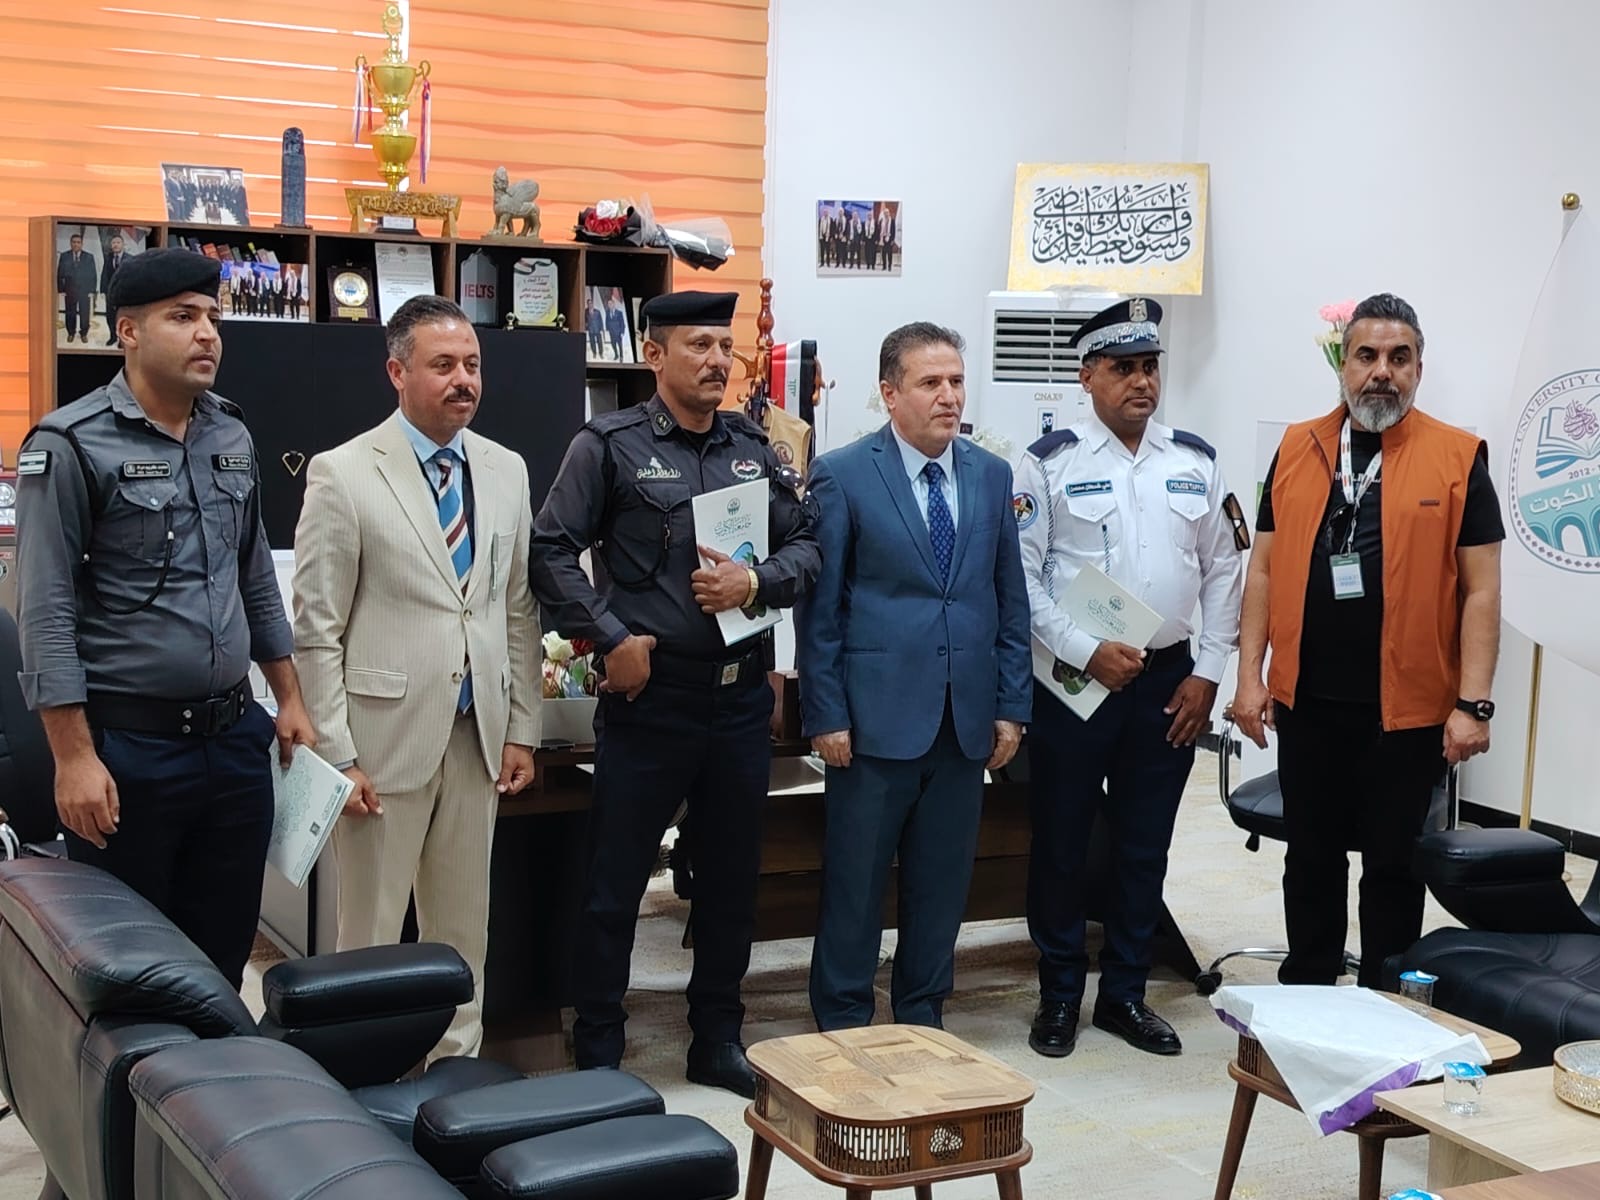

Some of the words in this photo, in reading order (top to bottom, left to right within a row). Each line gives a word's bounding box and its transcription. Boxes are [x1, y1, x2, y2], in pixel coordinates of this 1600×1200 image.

[464, 283, 495, 299] IELTS
[1517, 374, 1588, 441] UNIVERSITY
[1567, 467, 1590, 479] 2012
[1529, 482, 1594, 513] الكوت
